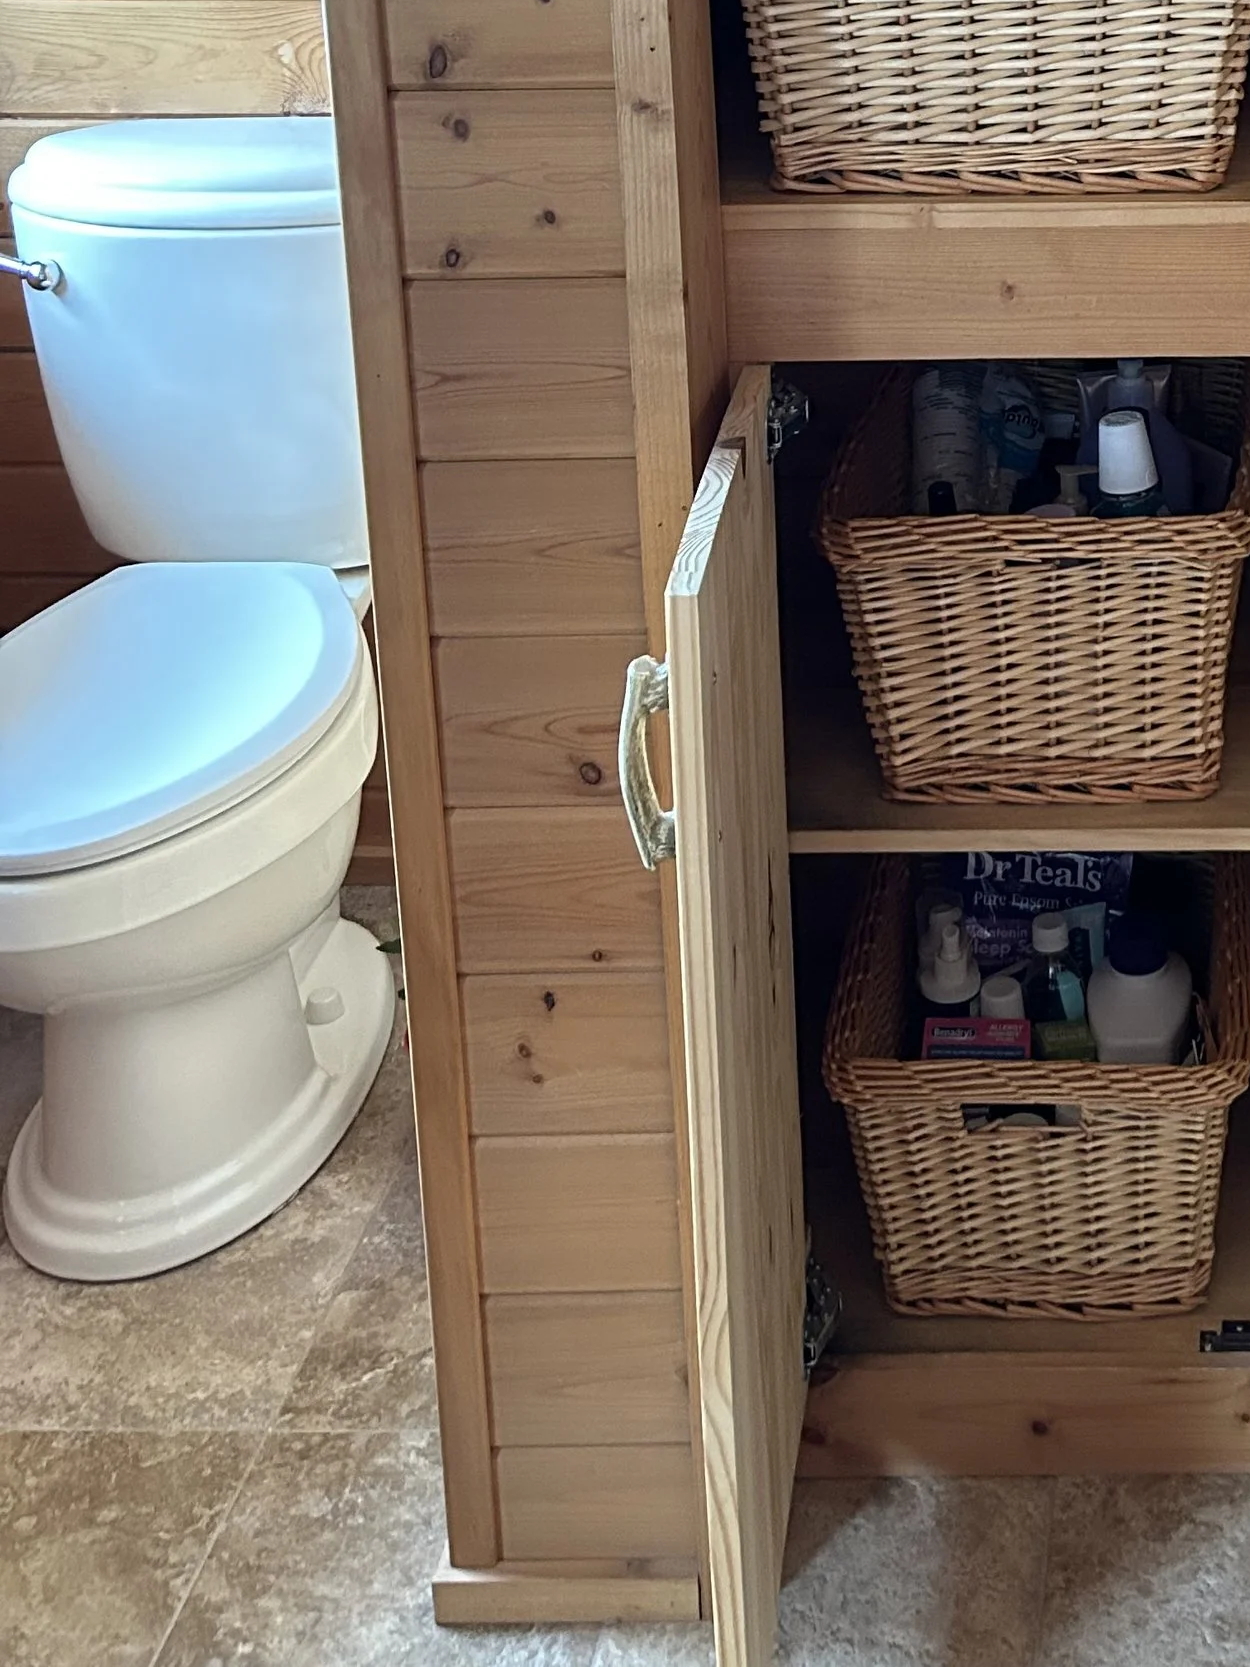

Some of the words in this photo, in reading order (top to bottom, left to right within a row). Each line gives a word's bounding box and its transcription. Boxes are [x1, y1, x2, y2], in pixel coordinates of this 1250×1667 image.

[963, 852, 1012, 881] Dr
[1015, 852, 1102, 892] Teal's
[973, 890, 1007, 907] Pure
[1011, 892, 1060, 911] Epsom
[934, 1027, 973, 1039] Benadryl
[989, 1023, 1024, 1032] ALLERGY
